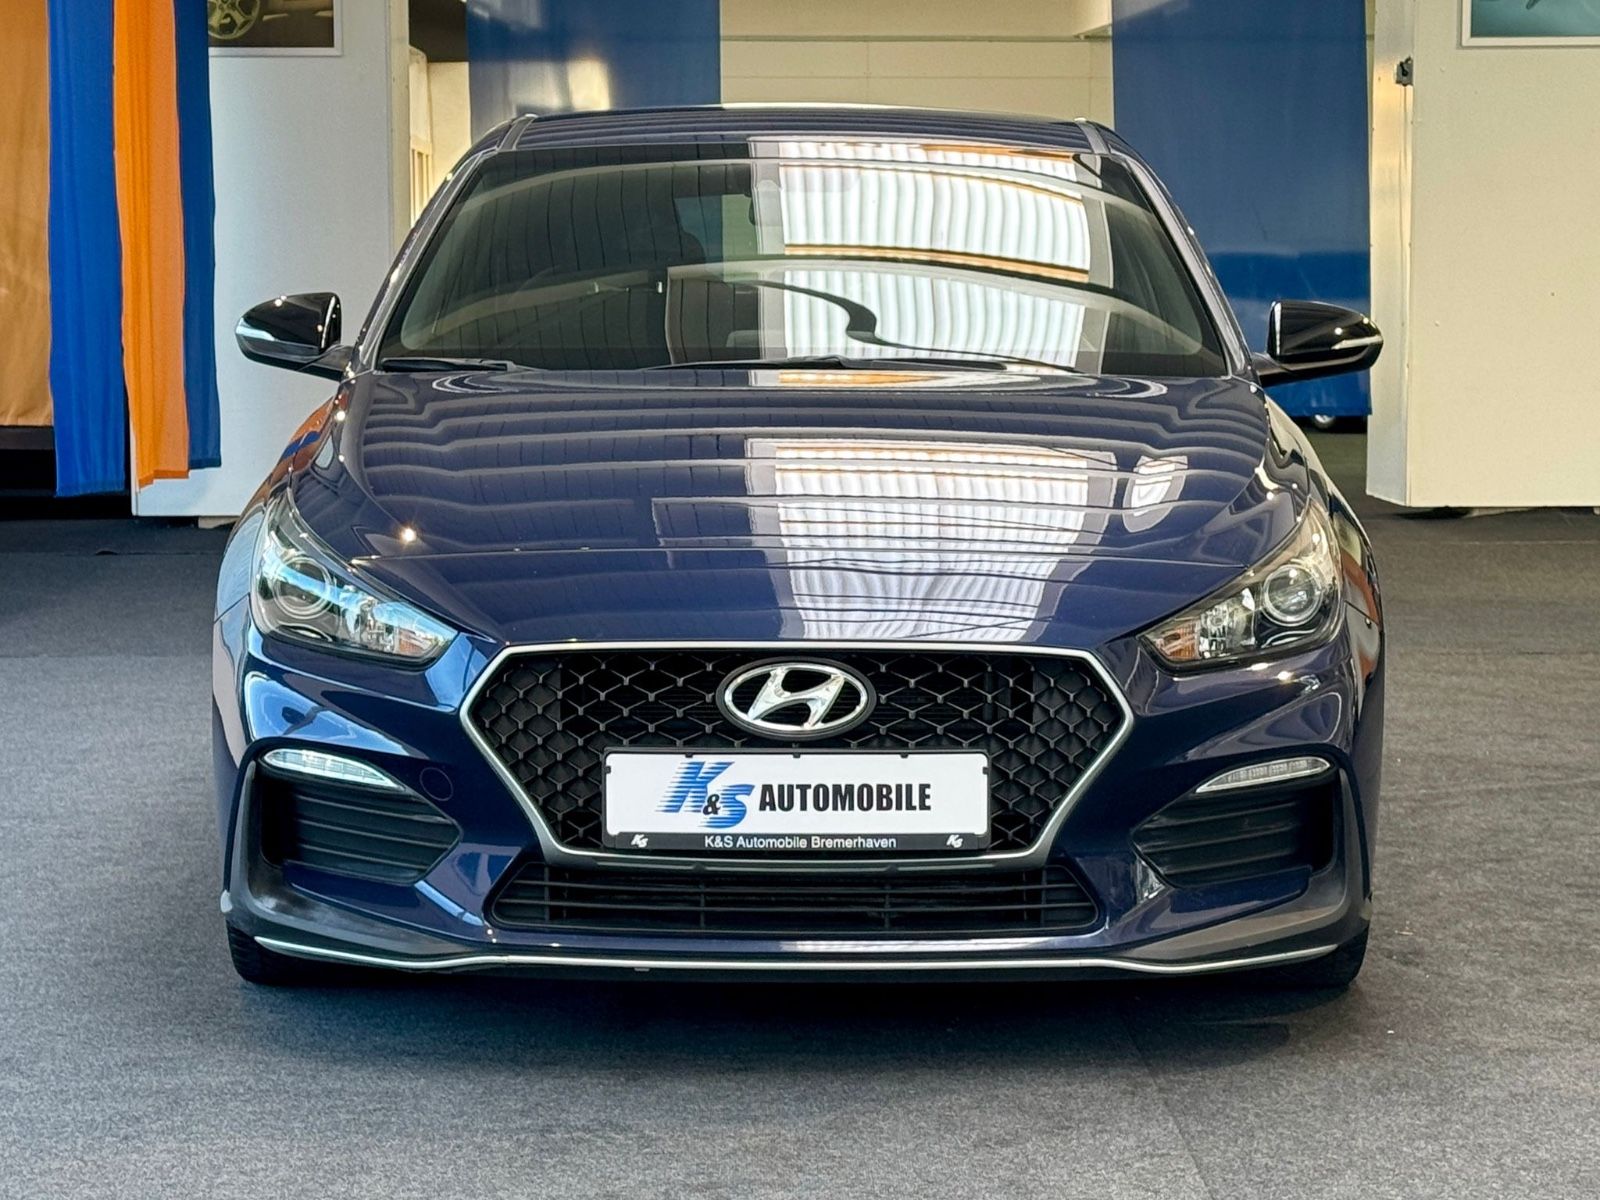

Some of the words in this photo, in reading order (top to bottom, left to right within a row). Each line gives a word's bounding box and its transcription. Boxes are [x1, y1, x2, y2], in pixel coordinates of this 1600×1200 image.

[654, 761, 756, 828] K&S
[758, 783, 932, 812] AUTOMOBILE
[704, 835, 733, 848] K&S
[736, 835, 808, 848] Automobile
[811, 835, 897, 848] Bremerhaven
